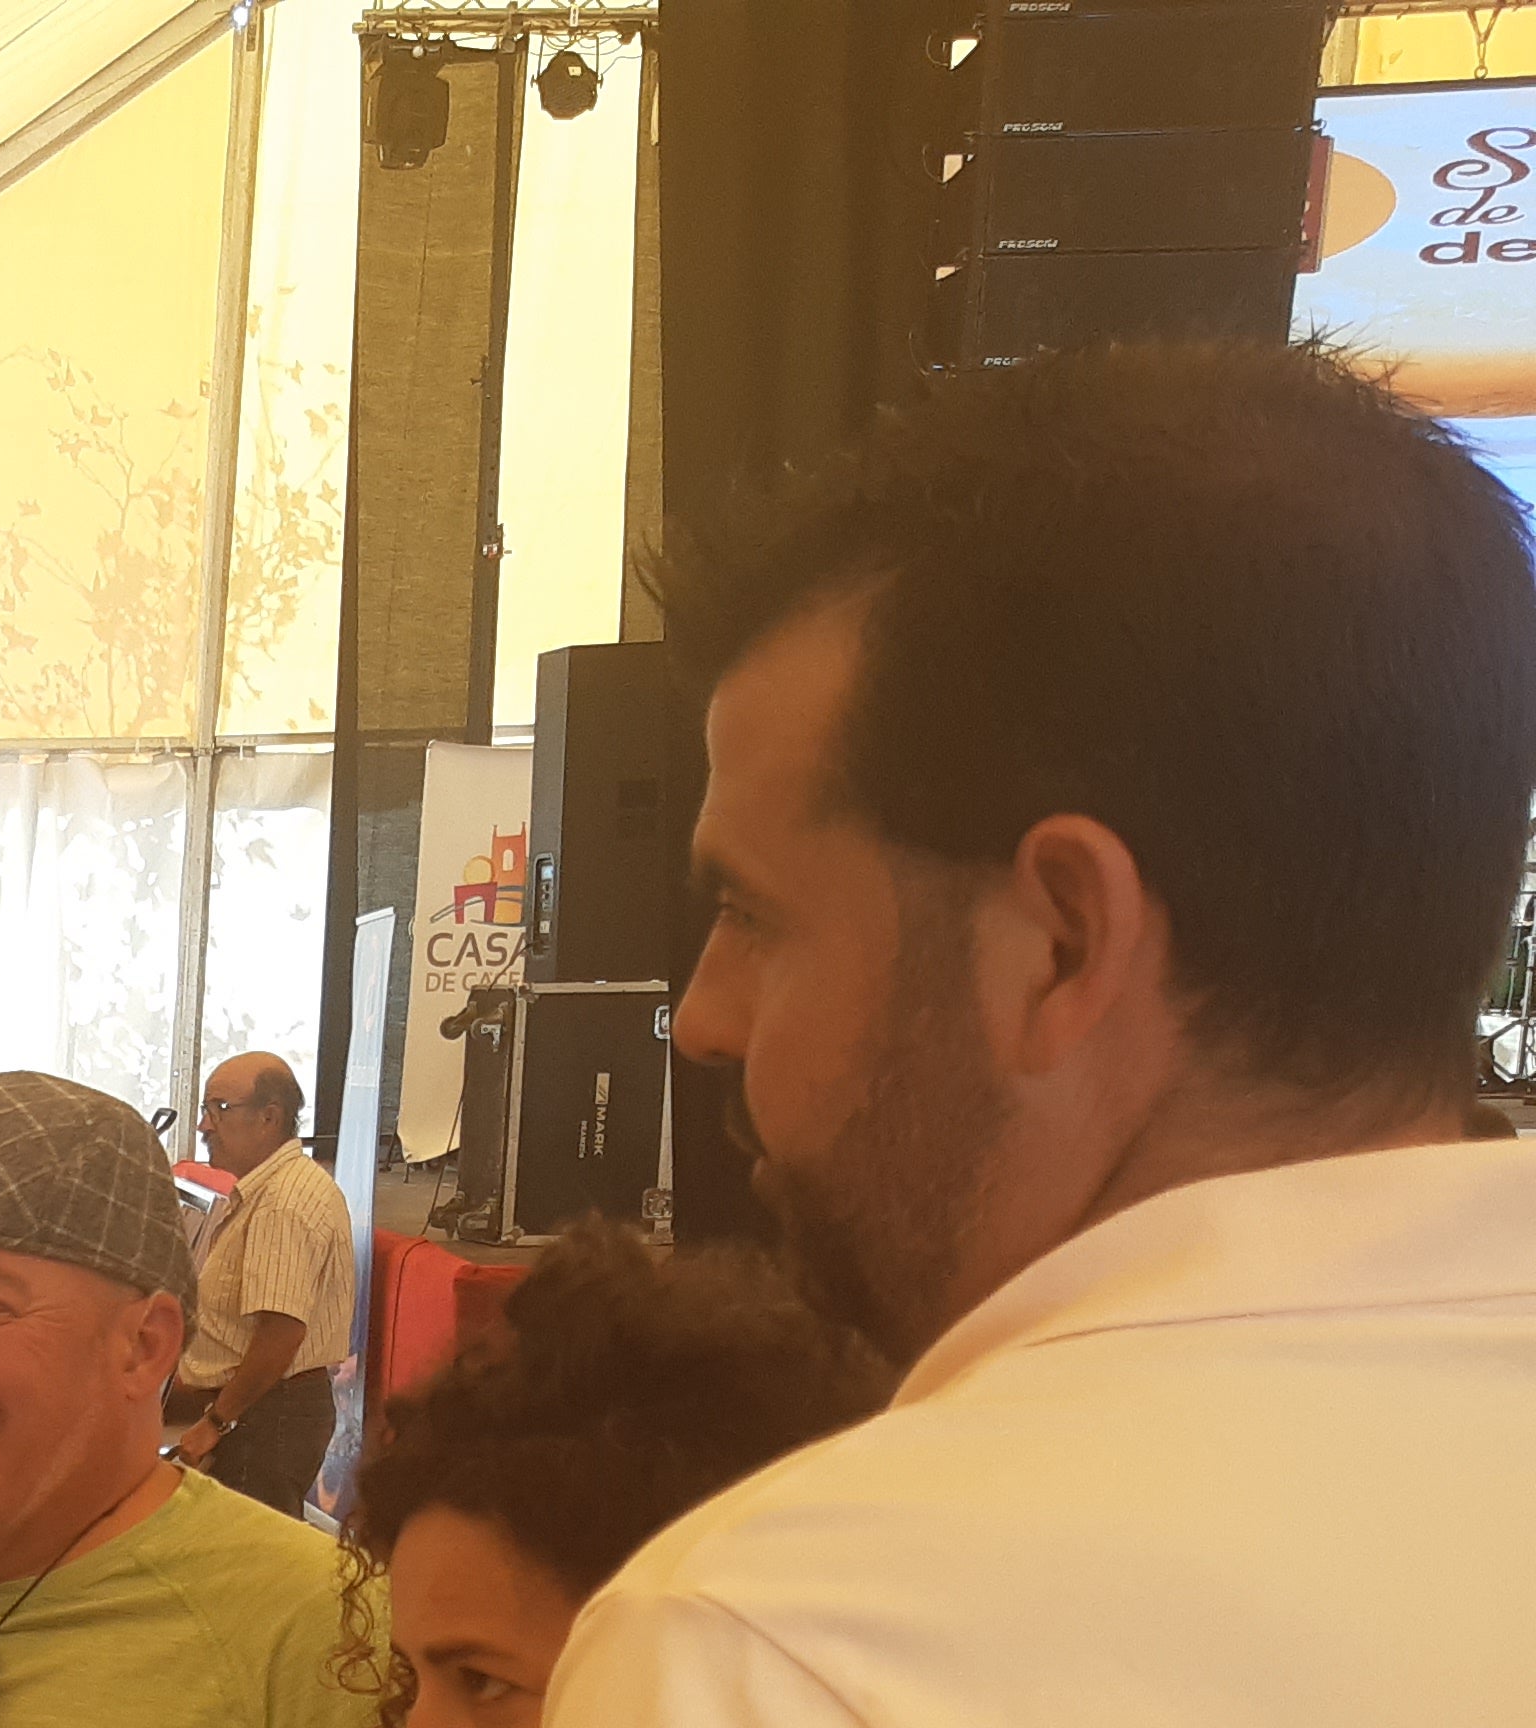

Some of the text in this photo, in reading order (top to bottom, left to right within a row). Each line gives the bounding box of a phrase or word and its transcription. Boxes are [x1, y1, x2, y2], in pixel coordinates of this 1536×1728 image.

[1429, 187, 1525, 226] de
[426, 972, 456, 992] DE
[593, 1106, 608, 1156] MARK
